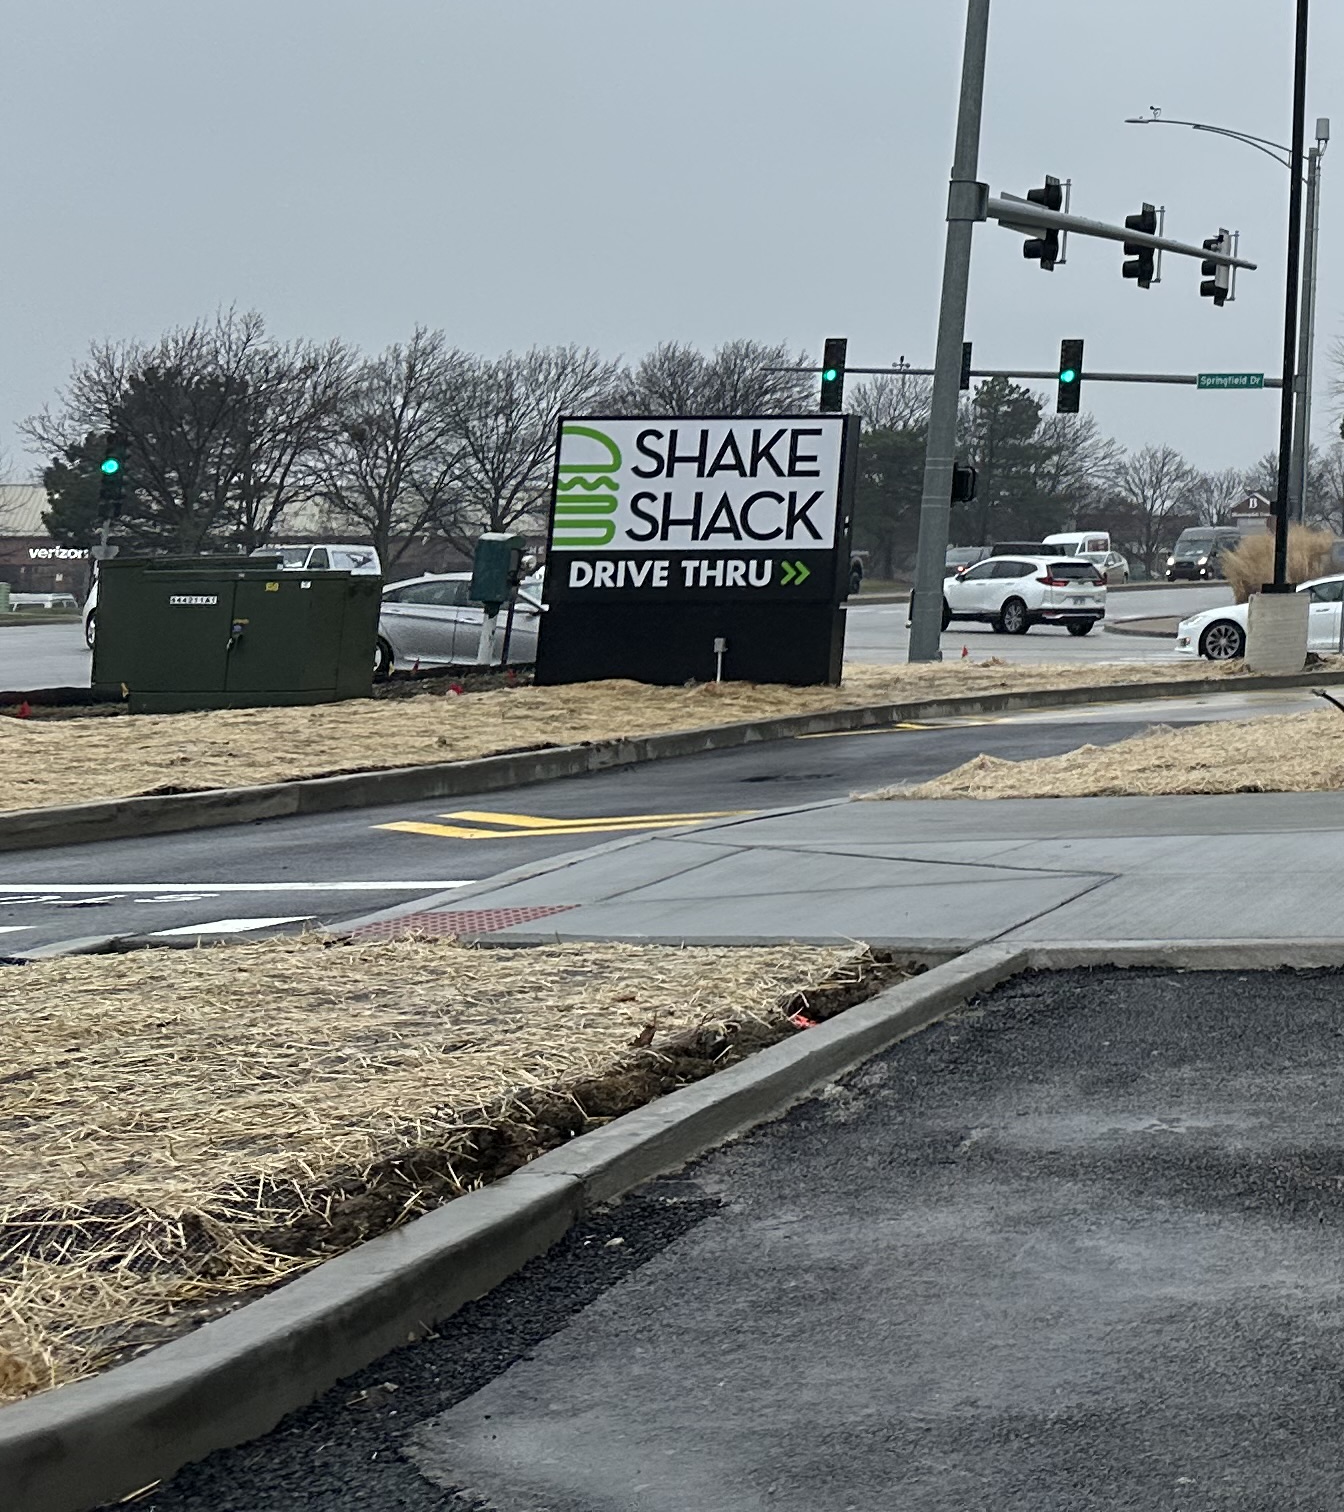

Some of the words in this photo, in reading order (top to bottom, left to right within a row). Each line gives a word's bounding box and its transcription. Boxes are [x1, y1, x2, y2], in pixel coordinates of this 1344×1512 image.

[1200, 376, 1248, 387] Springfield
[1250, 375, 1261, 385] Dr
[630, 428, 823, 479] SHAKE
[624, 490, 825, 542] SHACK
[569, 560, 669, 588] DRIVE
[681, 559, 773, 587] THRU
